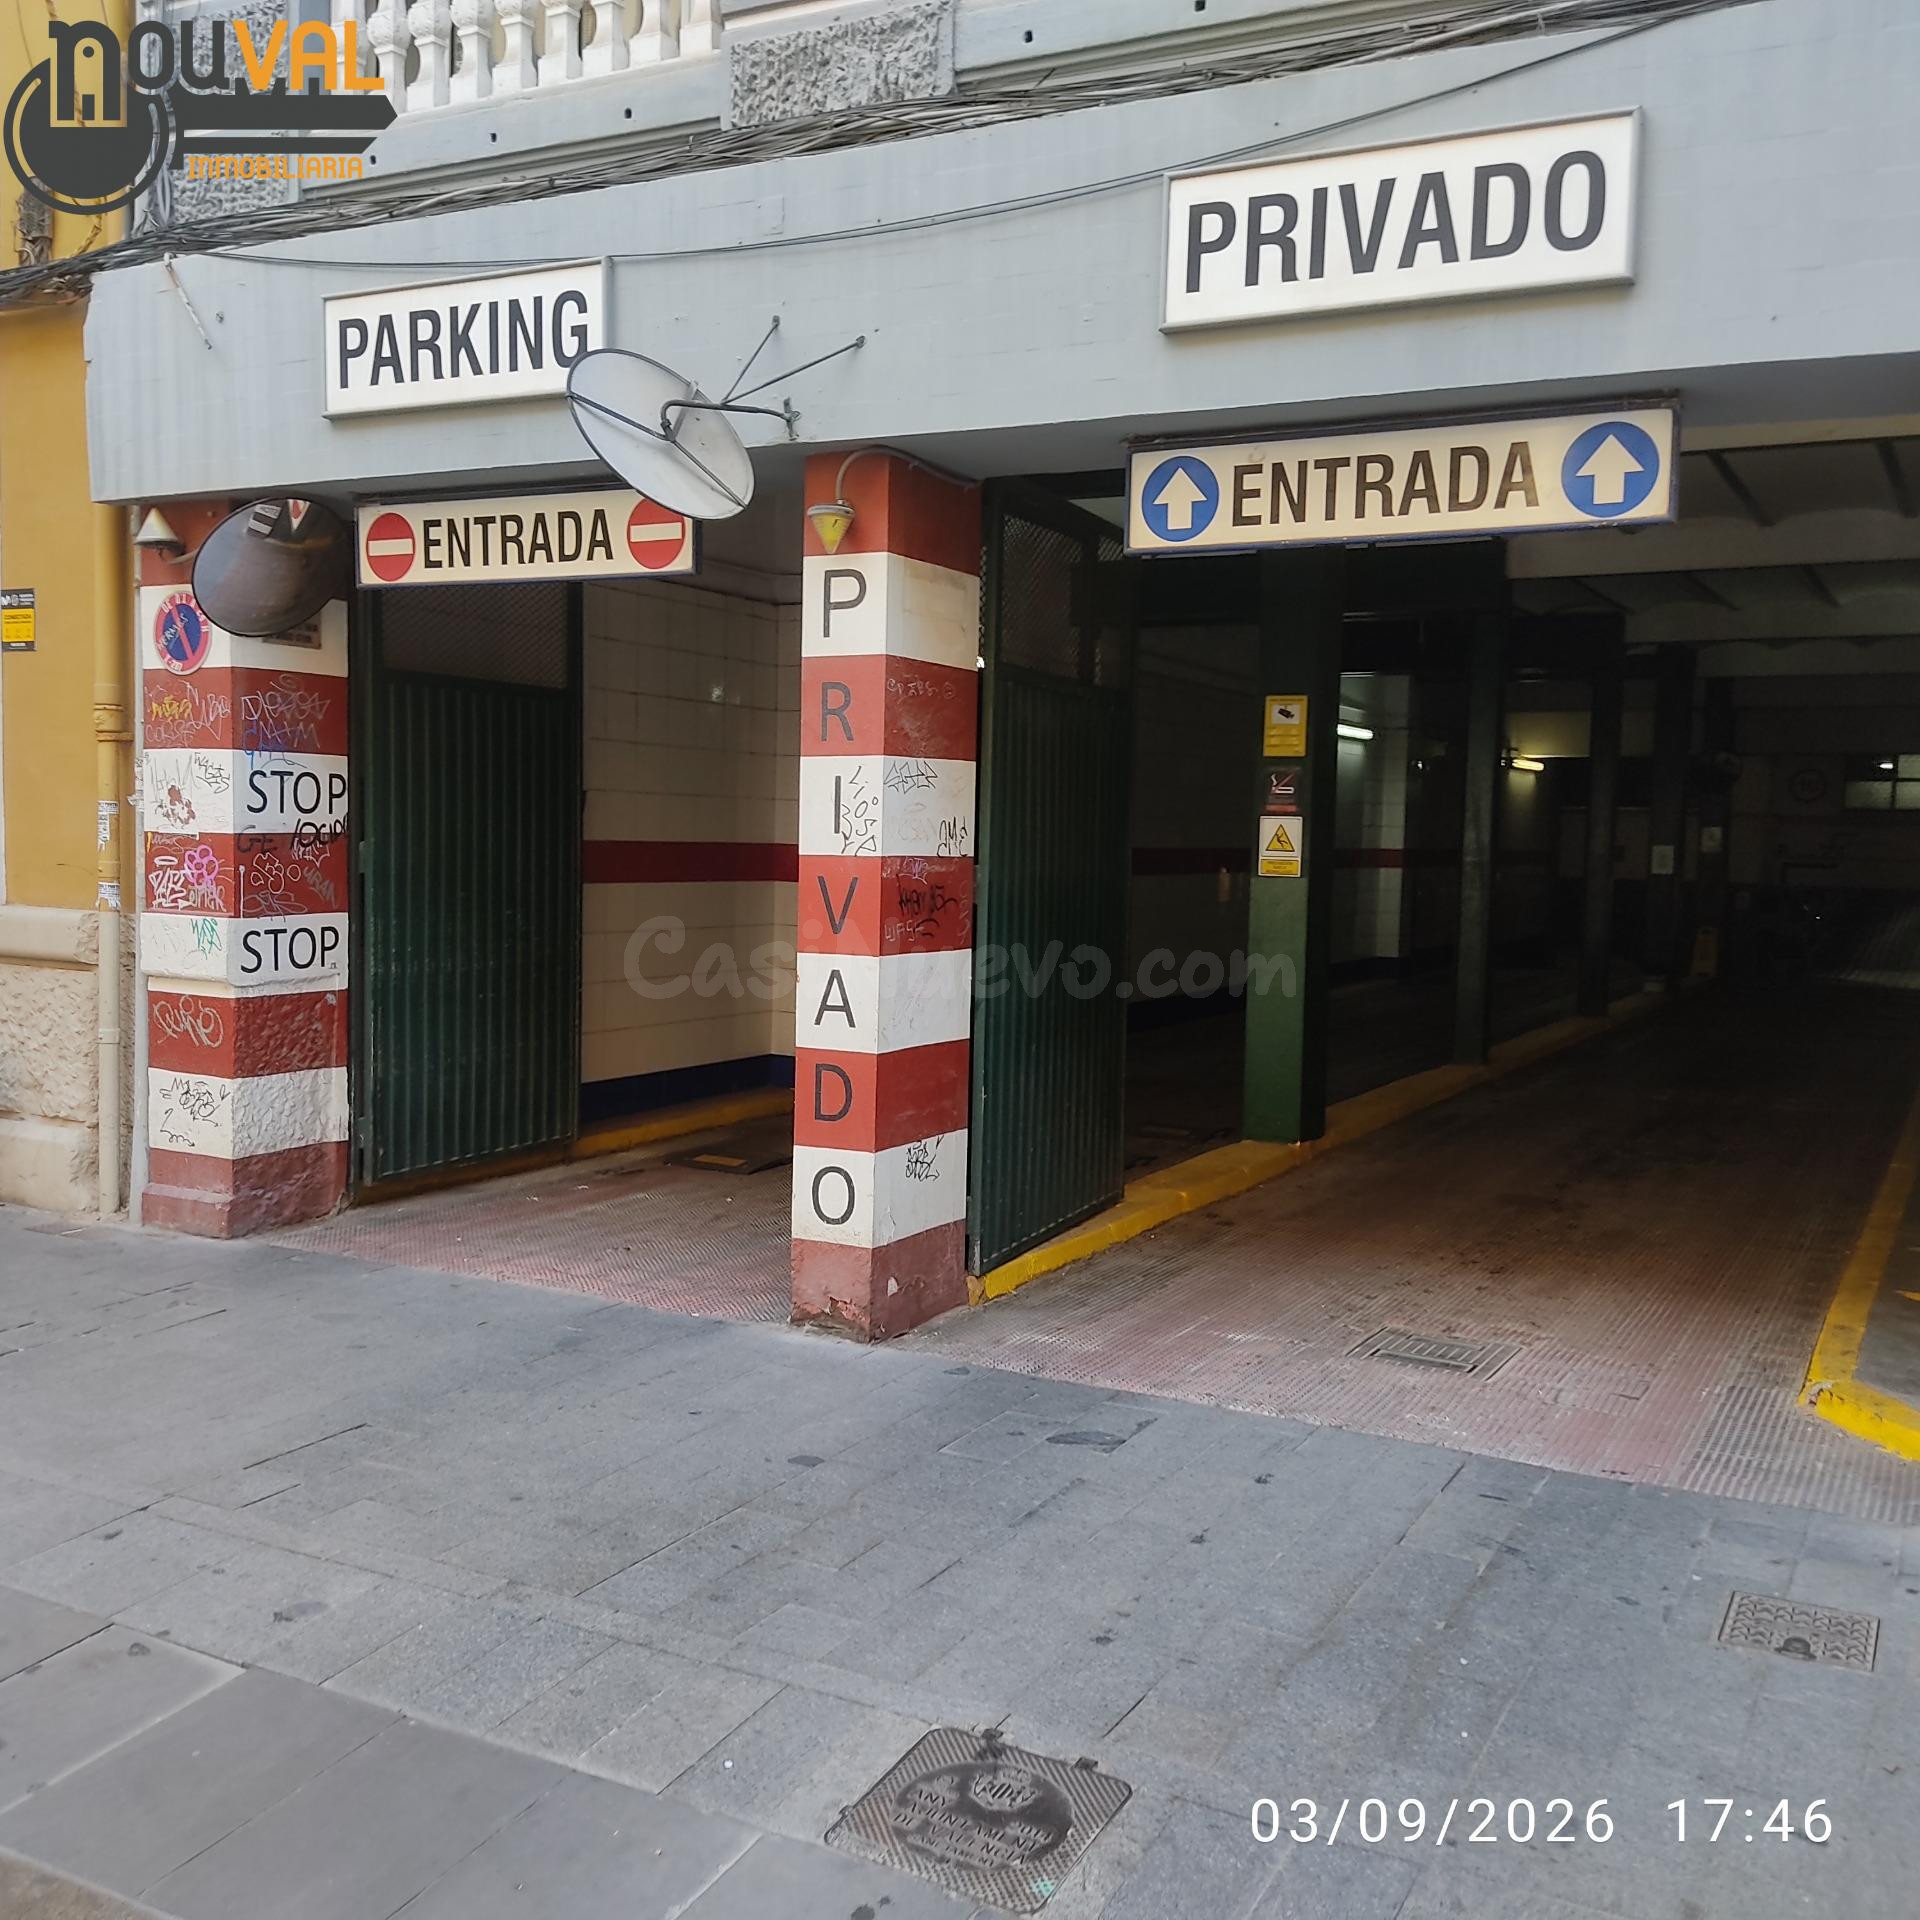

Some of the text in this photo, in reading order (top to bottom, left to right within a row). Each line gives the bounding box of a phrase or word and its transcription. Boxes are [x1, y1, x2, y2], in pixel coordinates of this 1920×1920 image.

[1186, 150, 1606, 294] PRIVADO
[338, 289, 589, 390] PARKING
[1231, 441, 1540, 528] ENTRADA
[422, 508, 614, 569] ENTRADA
[246, 769, 347, 815] STOP
[808, 568, 867, 1226] PRIVADO
[240, 926, 340, 974] STOP
